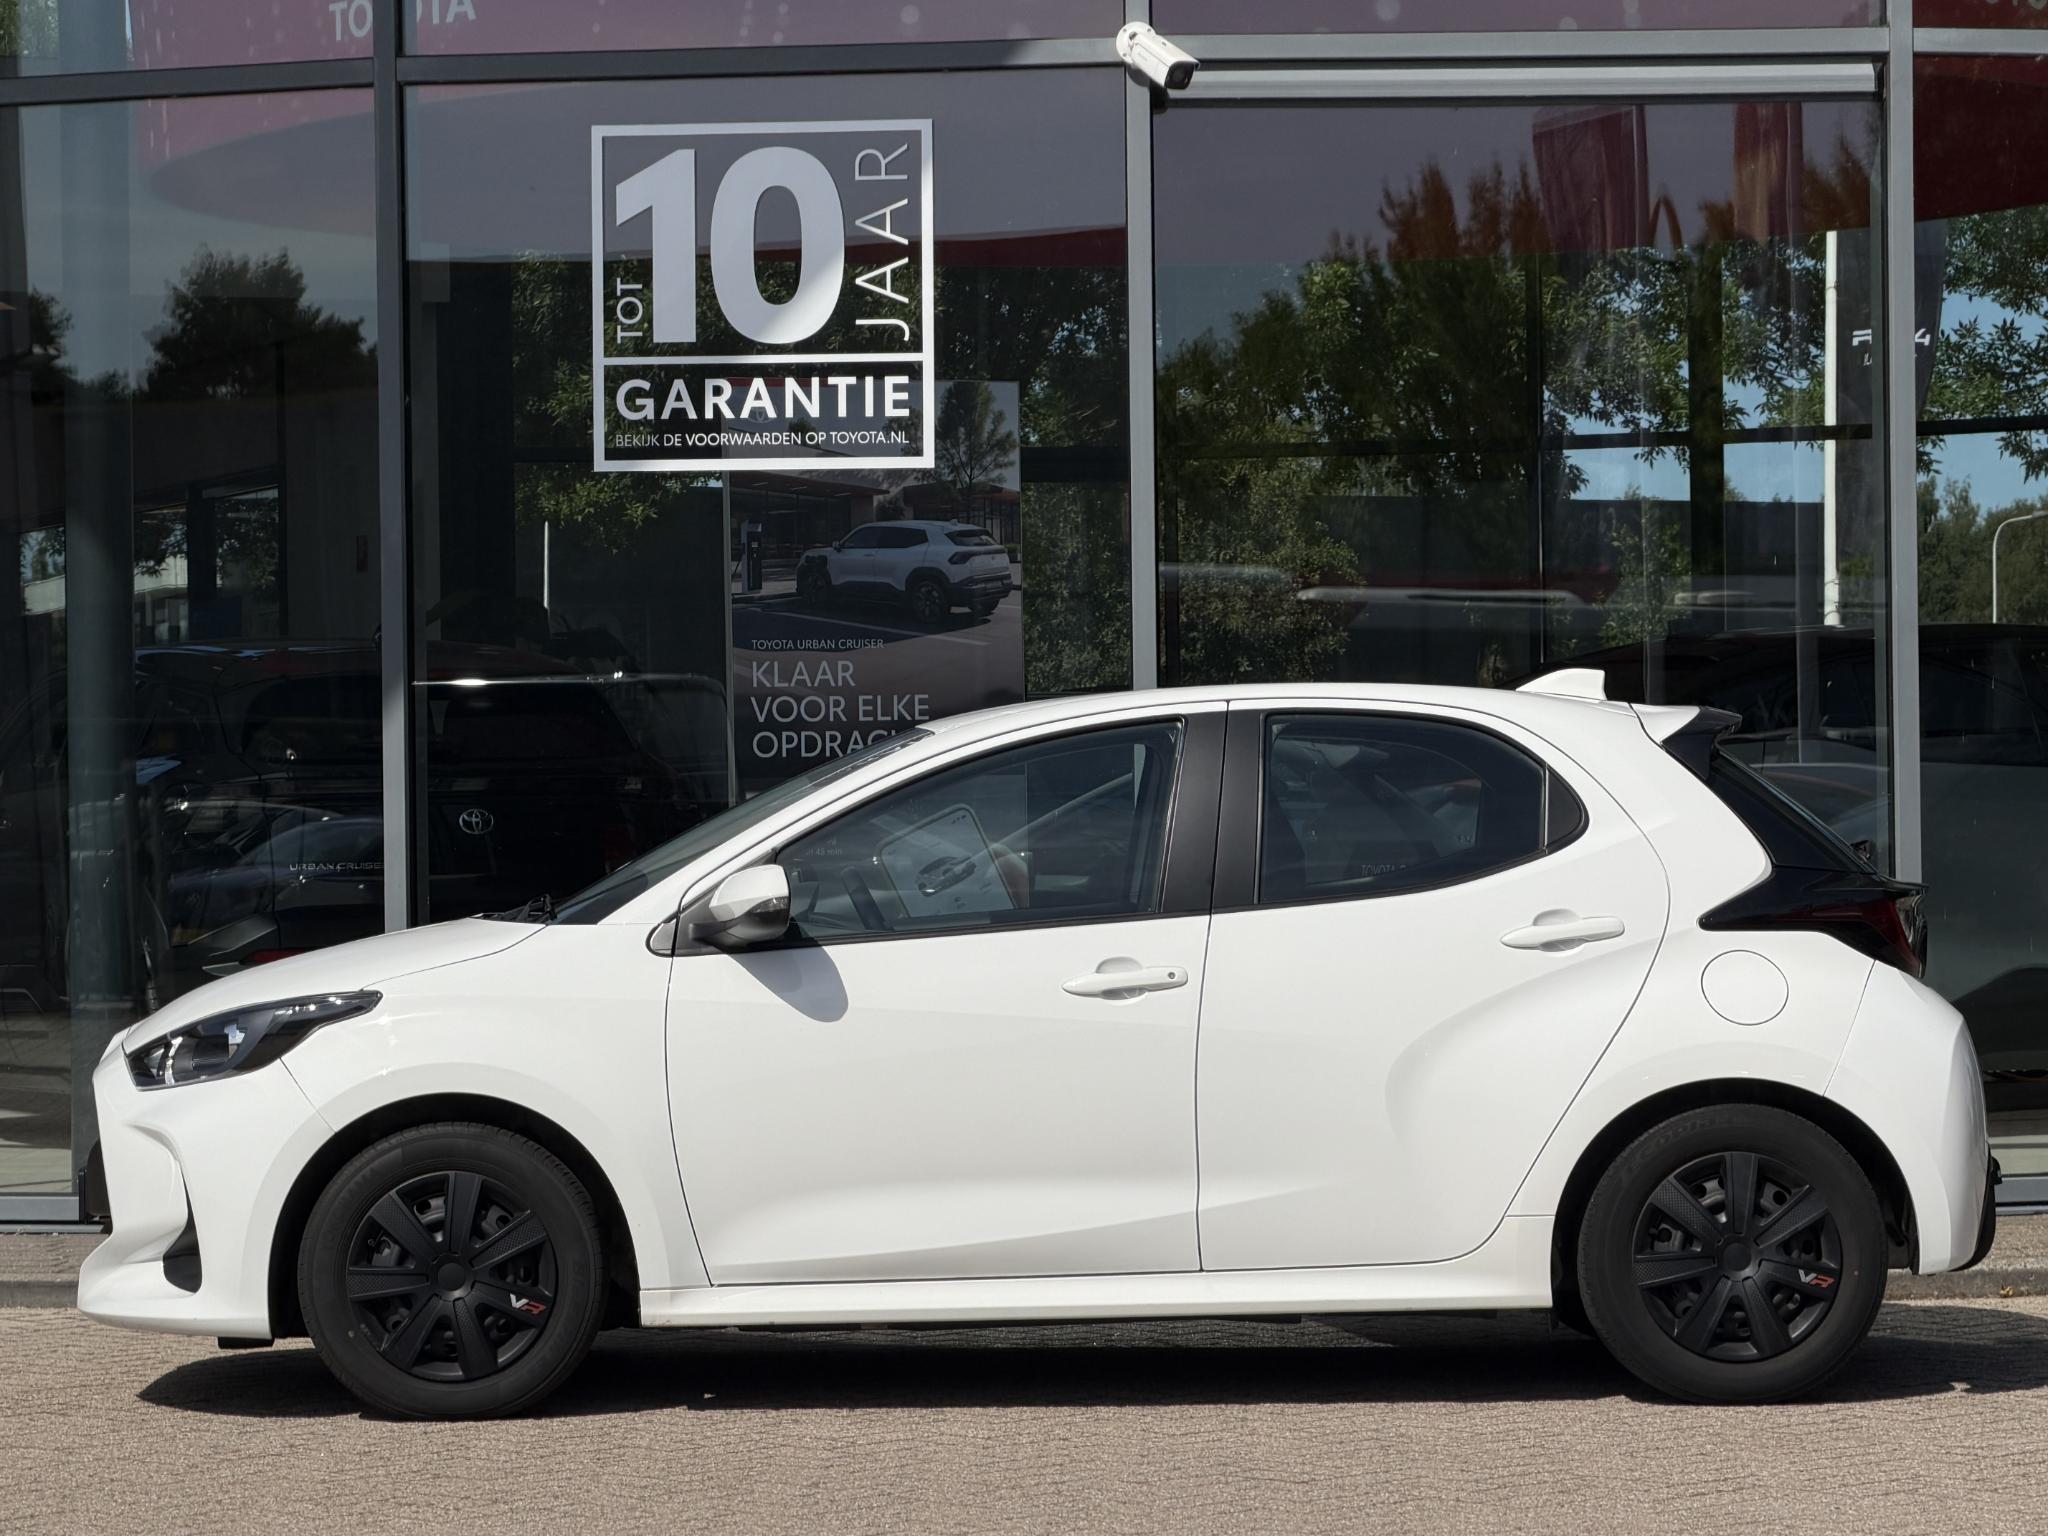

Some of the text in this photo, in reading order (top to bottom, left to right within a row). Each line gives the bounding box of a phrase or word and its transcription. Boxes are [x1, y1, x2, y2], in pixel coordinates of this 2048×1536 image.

[615, 146, 845, 345] 10
[855, 143, 909, 342] JAAR
[616, 277, 643, 344] TOT
[615, 375, 910, 420] GARANTIE
[615, 430, 909, 447] BEKIJK DE VOORWAARDEN OP TOYOTA.NL
[752, 638, 884, 649] TOYOTA URBAN CRUISER
[751, 660, 856, 687] KLAAR
[750, 694, 929, 723] VOOR ELKE
[337, 862, 384, 870] CRUISE
